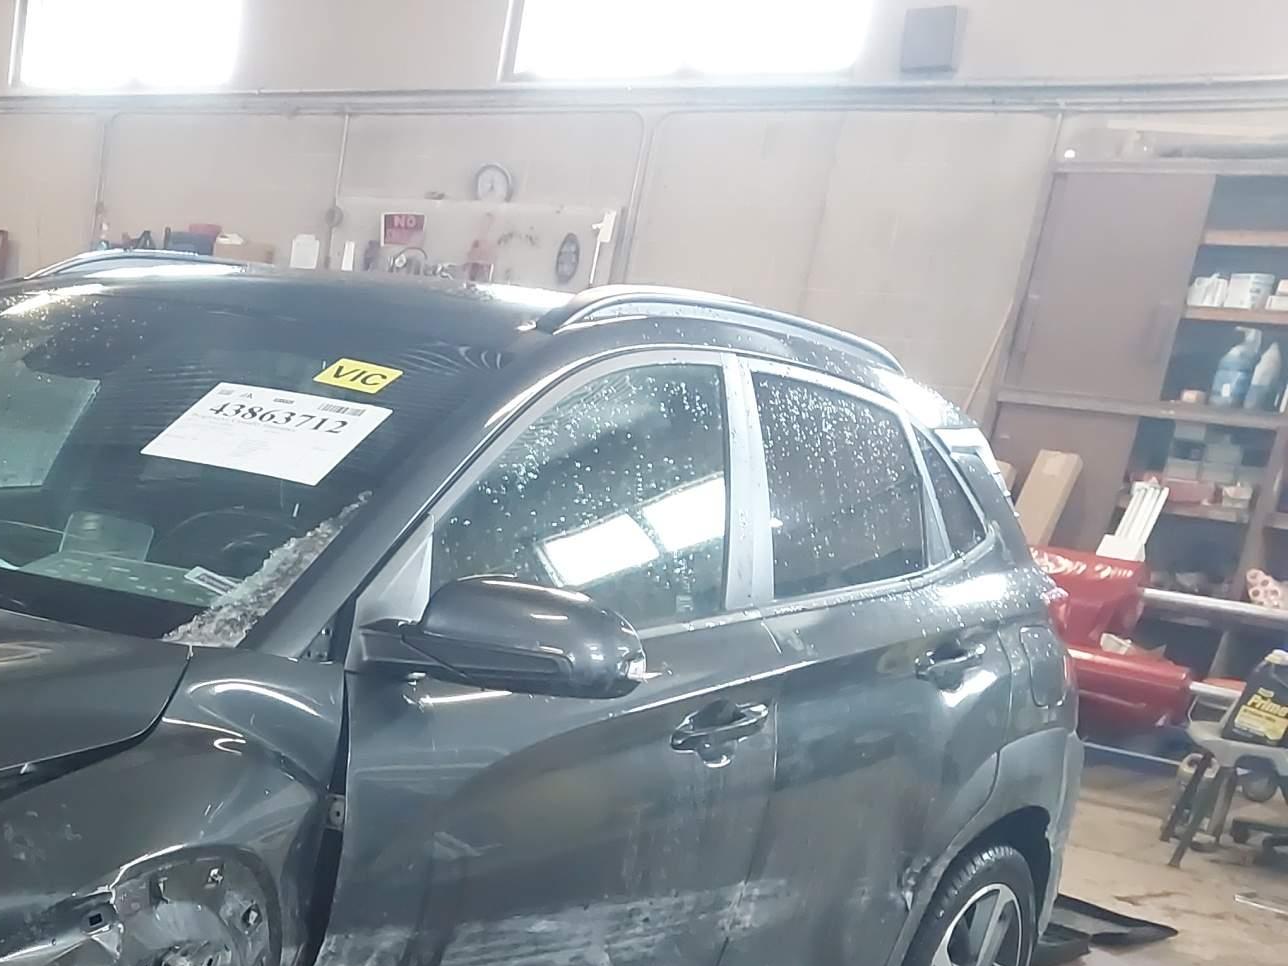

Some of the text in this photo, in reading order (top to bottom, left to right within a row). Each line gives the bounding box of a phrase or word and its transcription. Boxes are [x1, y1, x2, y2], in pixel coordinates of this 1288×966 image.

[393, 215, 416, 228] NO
[333, 365, 388, 386] VIC
[209, 401, 349, 434] 43863712
